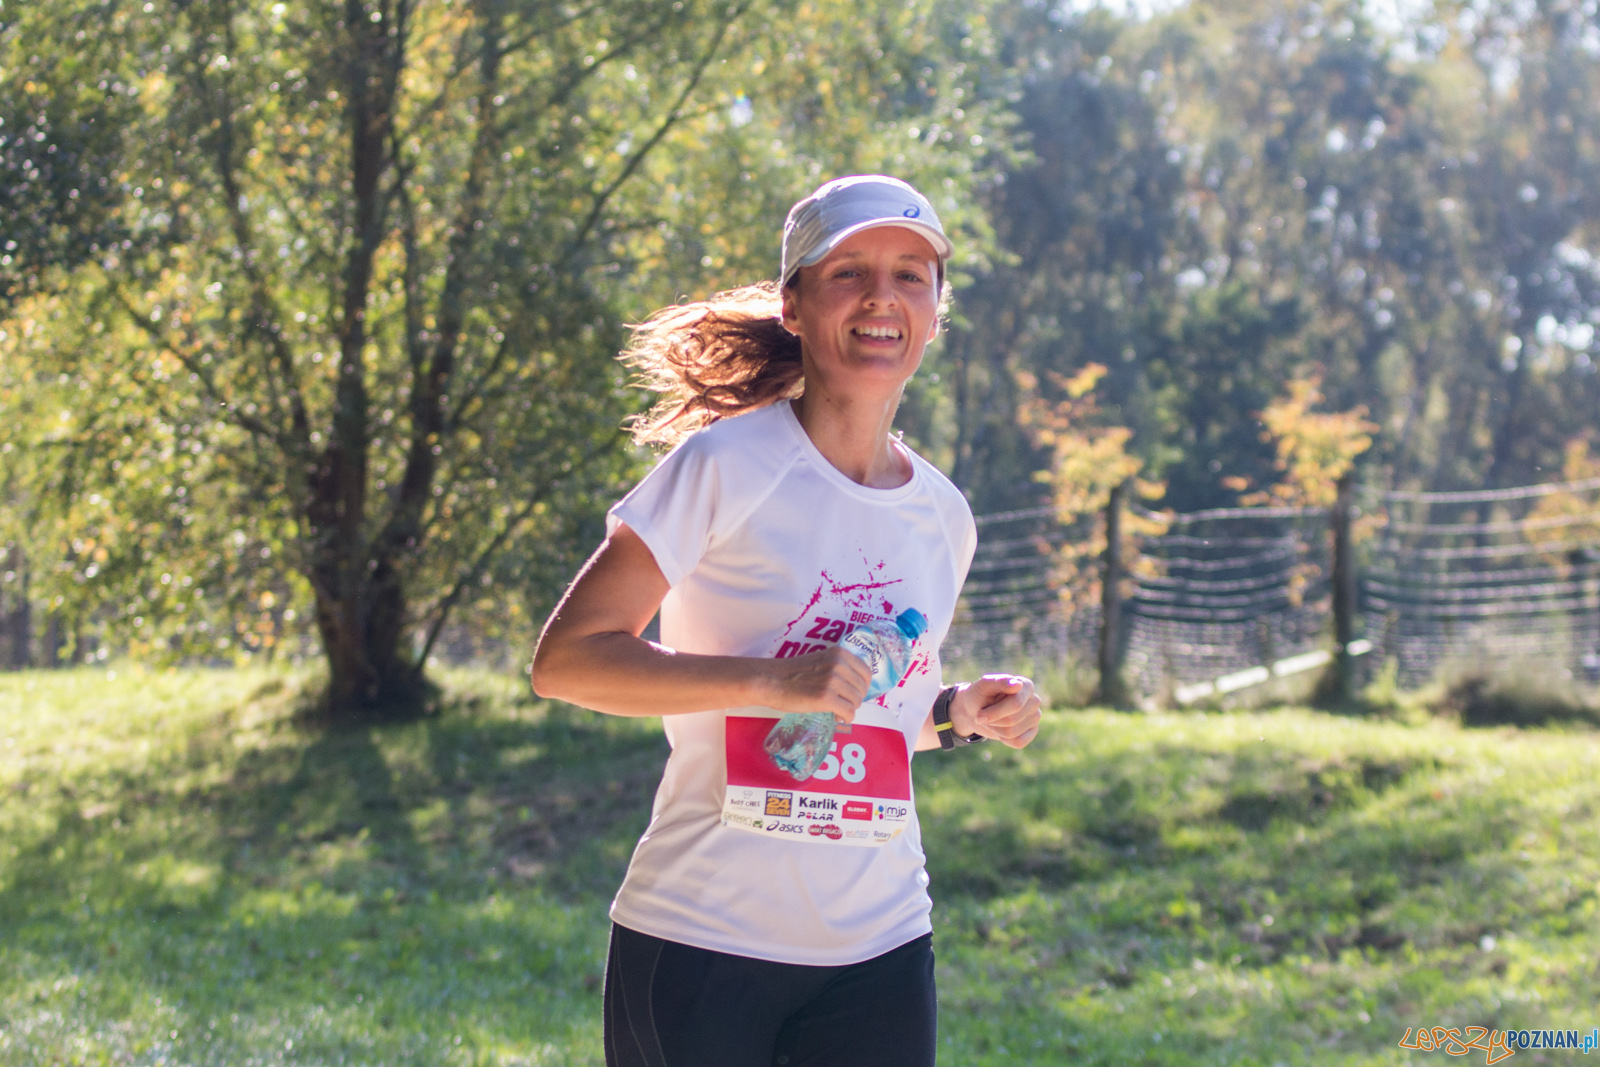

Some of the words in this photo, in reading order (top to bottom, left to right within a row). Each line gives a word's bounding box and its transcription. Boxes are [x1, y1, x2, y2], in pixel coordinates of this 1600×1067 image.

[766, 797, 791, 810] 24
[799, 797, 838, 810] Karlik
[766, 808, 791, 816] SEVEN
[797, 812, 834, 821] POLAR
[886, 806, 907, 817] mjp
[874, 831, 892, 839] Rotary
